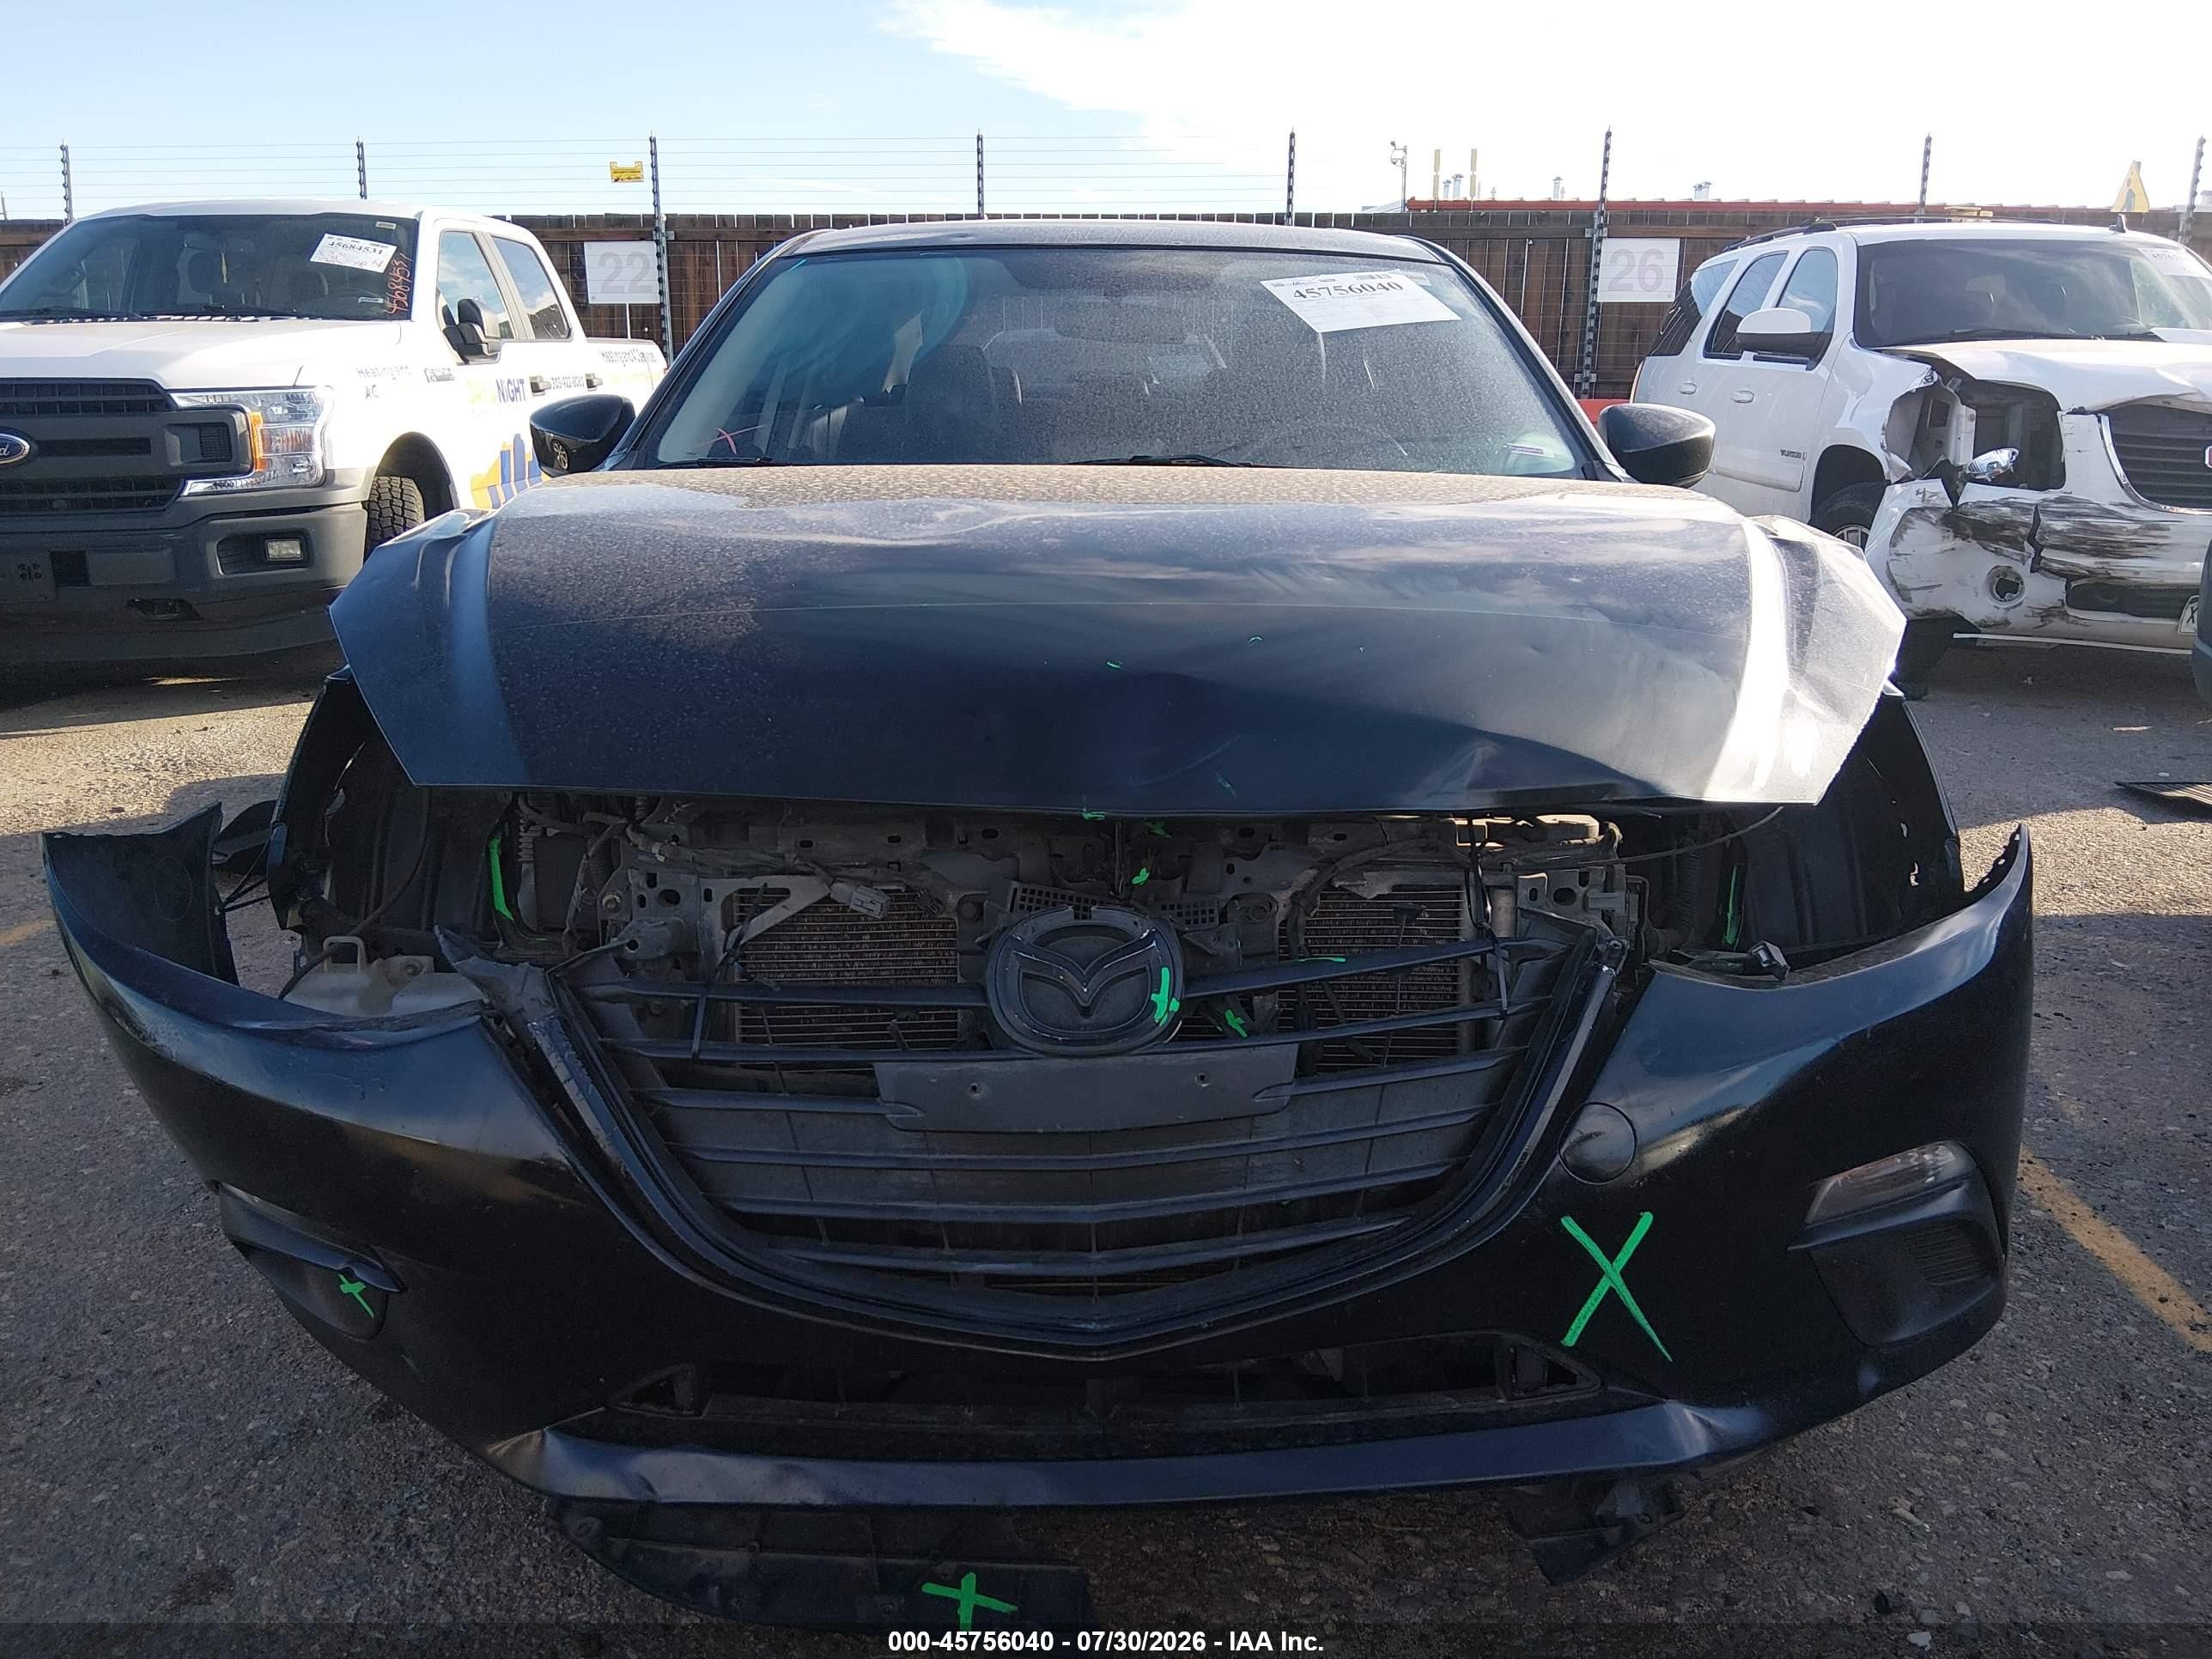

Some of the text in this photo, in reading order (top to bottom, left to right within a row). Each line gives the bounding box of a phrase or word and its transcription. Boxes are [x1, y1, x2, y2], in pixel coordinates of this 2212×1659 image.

[326, 241, 383, 255] 45684531
[385, 252, 413, 314] 45684531
[599, 252, 653, 294] 22
[1607, 248, 1664, 292] 26
[1293, 281, 1404, 299] 45756040
[365, 384, 380, 398] AC
